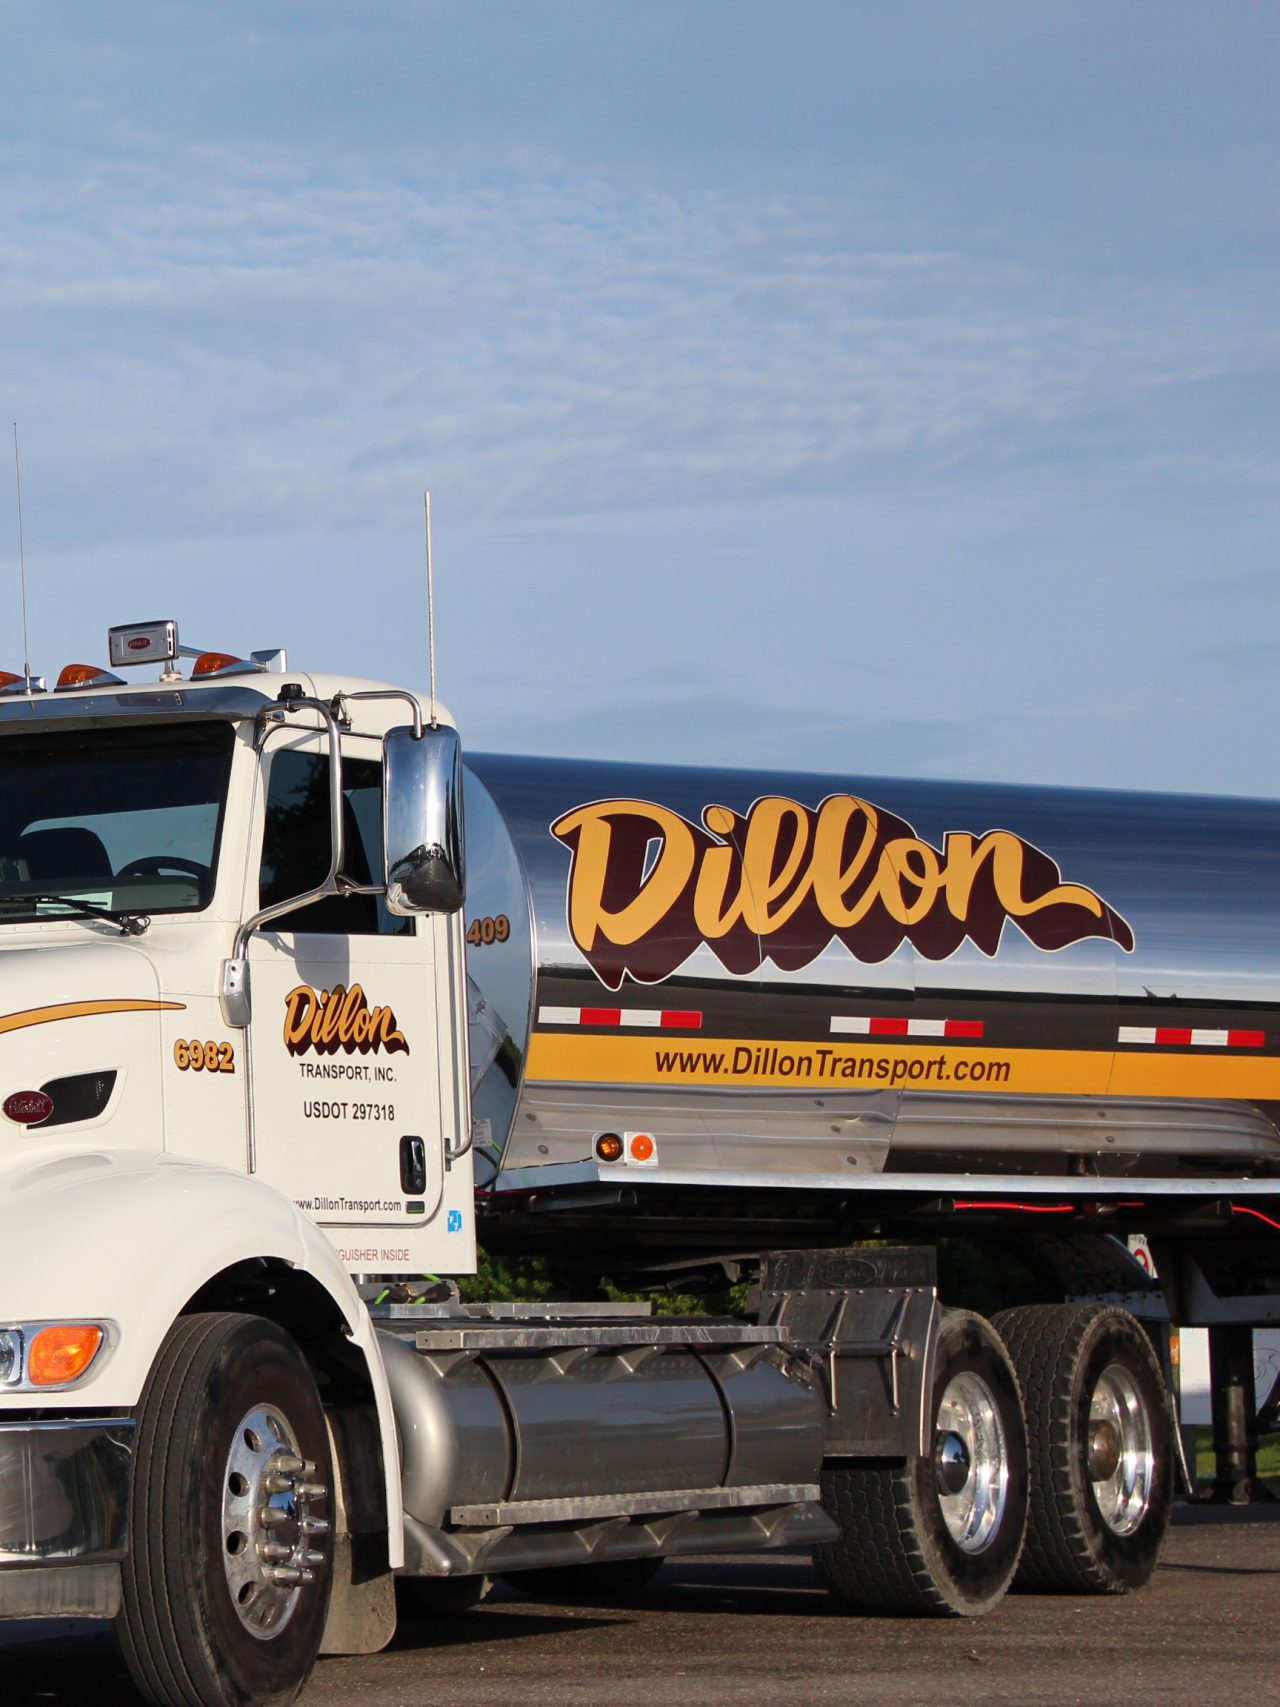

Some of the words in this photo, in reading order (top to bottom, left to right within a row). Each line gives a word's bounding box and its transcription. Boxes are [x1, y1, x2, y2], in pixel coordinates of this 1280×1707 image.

[548, 793, 1135, 991] Dillon
[466, 914, 510, 947] 409
[283, 983, 410, 1057] Dillon
[174, 1039, 235, 1073] 6982
[655, 1046, 1011, 1085] www.DillonTransport.com
[299, 1063, 372, 1083] TRANSPORT,
[374, 1066, 397, 1082] INC.
[303, 1101, 348, 1119] USDOT
[352, 1103, 395, 1121] 297318
[336, 1248, 378, 1261] GUISHER
[380, 1249, 410, 1261] INSIDE
